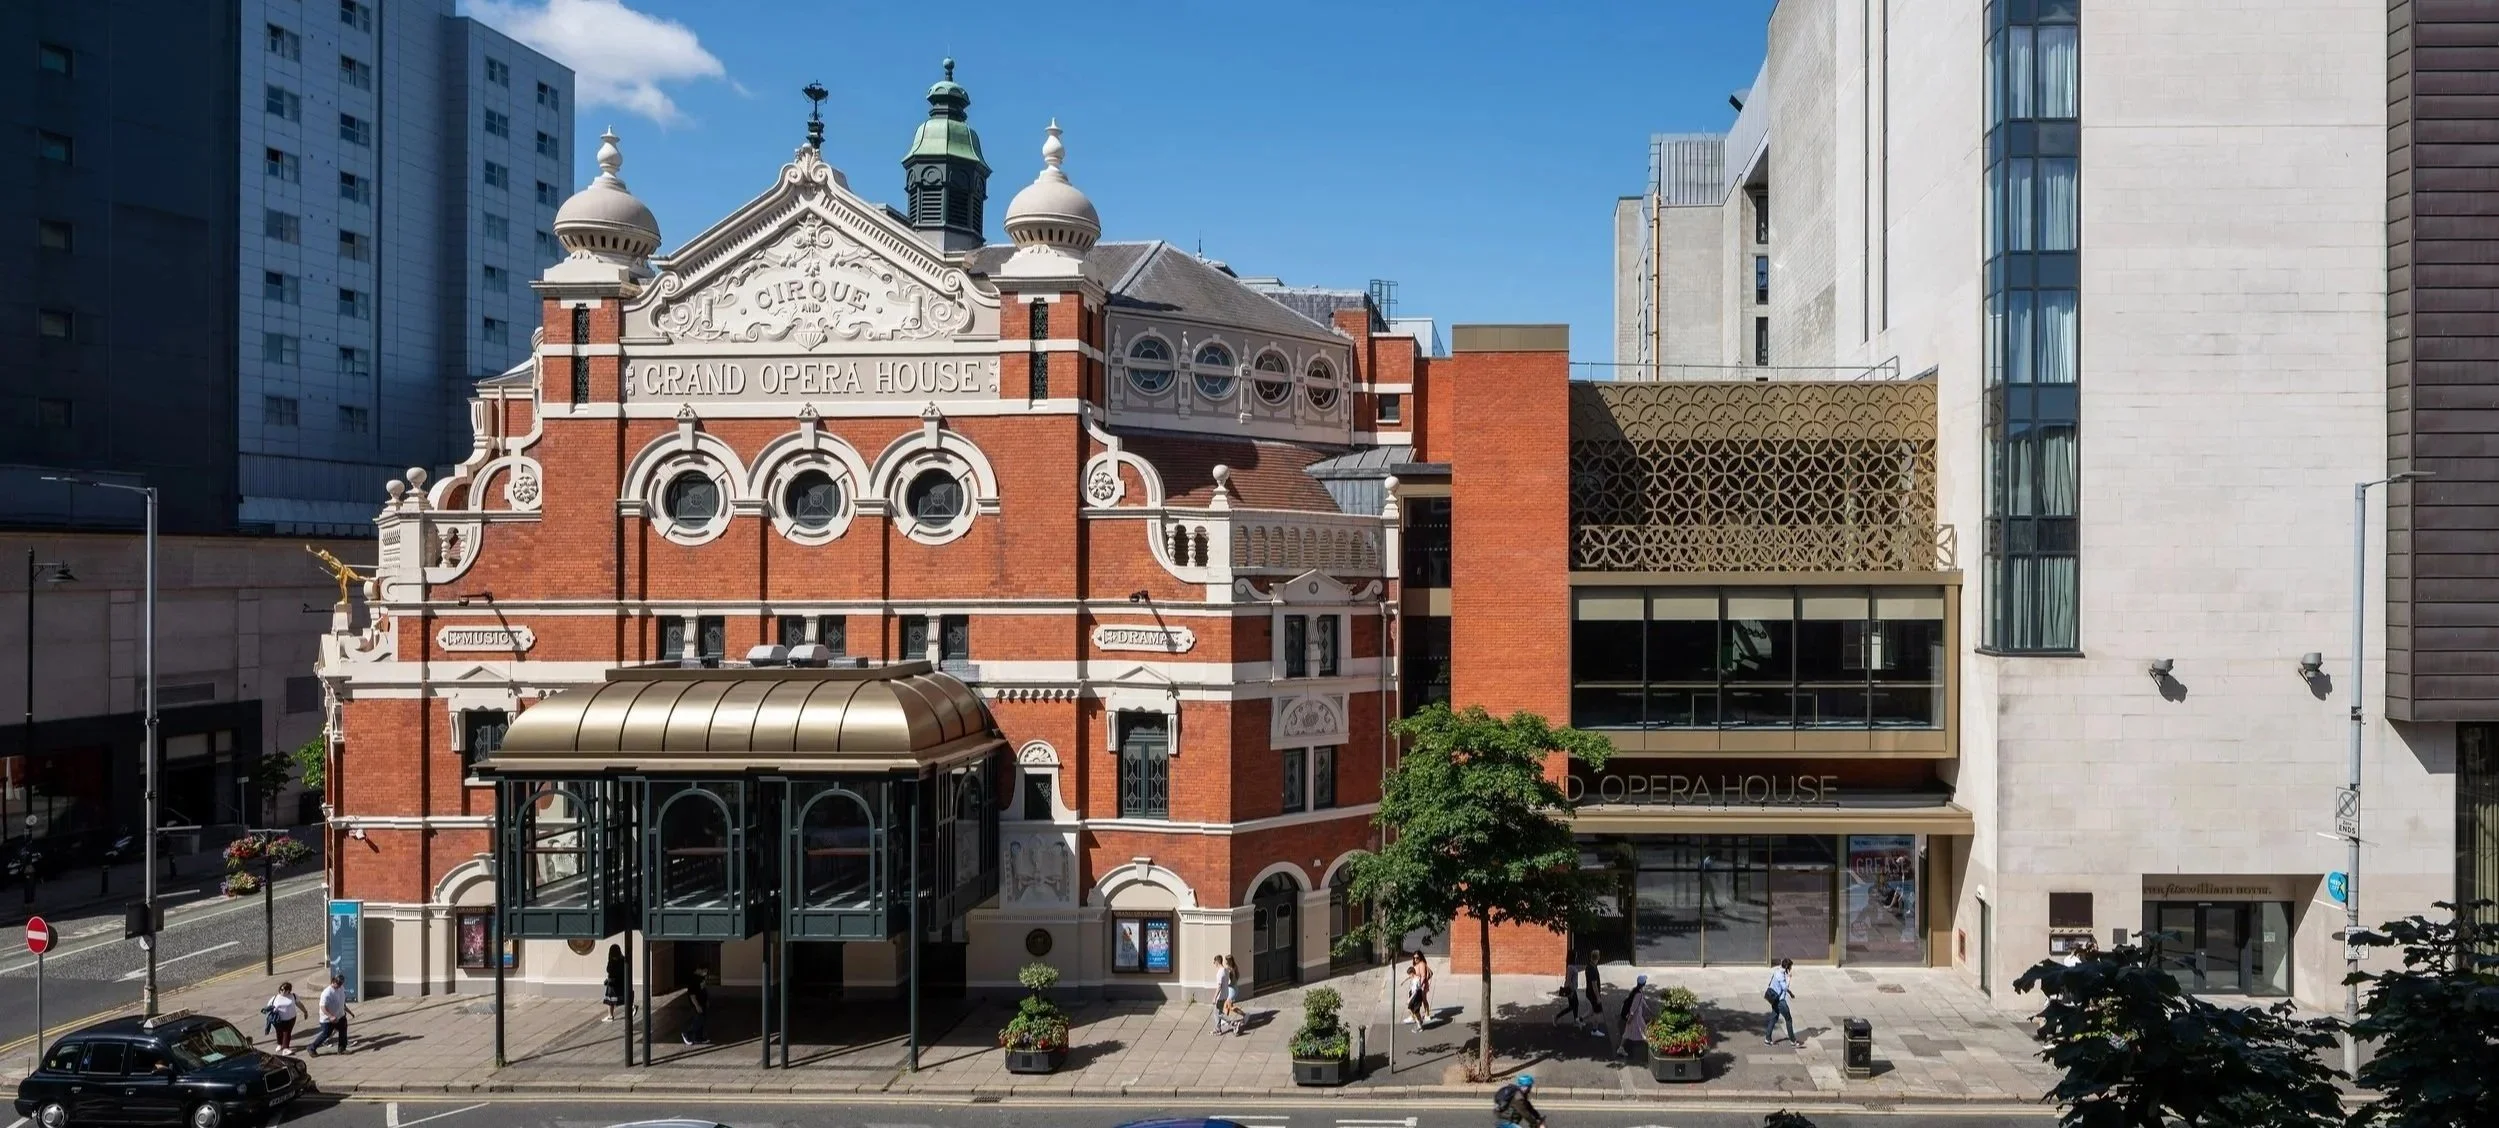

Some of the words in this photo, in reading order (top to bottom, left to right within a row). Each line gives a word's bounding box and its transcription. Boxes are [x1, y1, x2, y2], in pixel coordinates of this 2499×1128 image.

[755, 279, 870, 311] CIRQUE
[801, 303, 821, 313] AND
[642, 362, 747, 396] GRAND
[758, 362, 864, 395] OPERA
[875, 360, 981, 393] HOUSE
[463, 631, 510, 645] MUSIC
[1119, 631, 1168, 646] DRAMA
[1600, 775, 1713, 803] OPERA
[1721, 775, 1839, 803] HOUSE
[2338, 825, 2356, 835] ENDS
